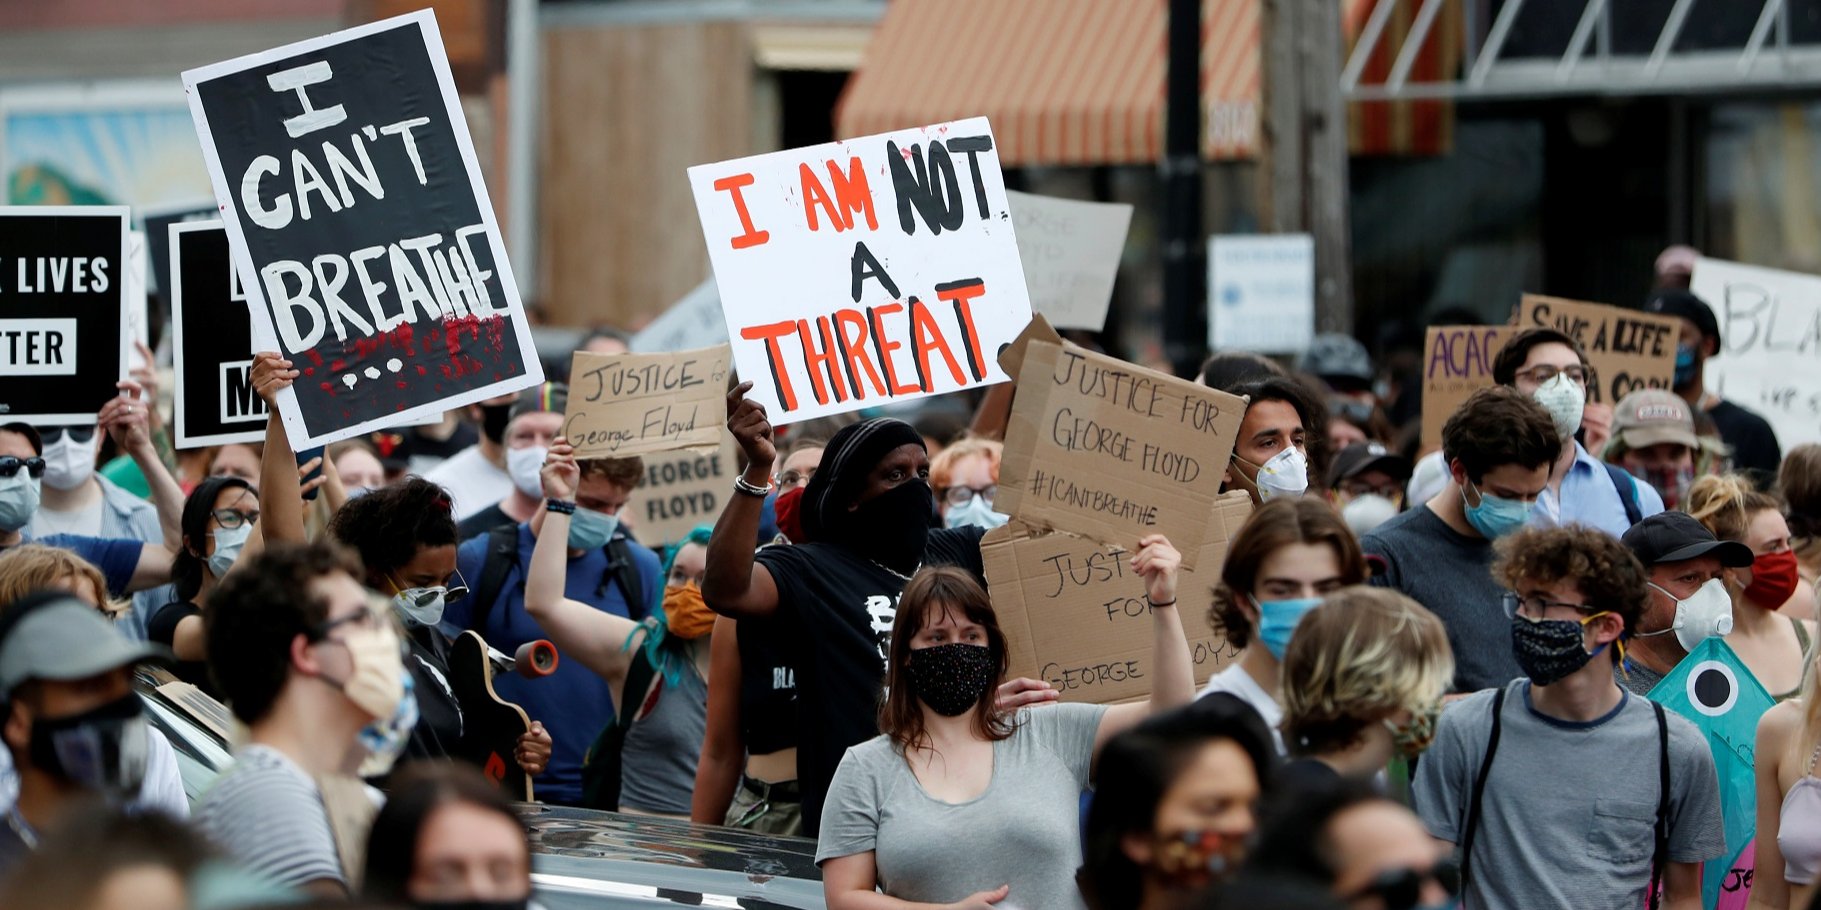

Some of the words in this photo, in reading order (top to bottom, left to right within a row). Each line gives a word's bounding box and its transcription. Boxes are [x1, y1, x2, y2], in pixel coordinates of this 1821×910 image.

[266, 60, 348, 139] I
[241, 116, 430, 230] CAN'T
[713, 172, 770, 250] I
[799, 156, 879, 232] AM
[886, 134, 993, 236] NOT
[17, 256, 110, 294] LIVES
[261, 223, 512, 355] BREATHE
[851, 241, 901, 303] A
[740, 277, 988, 413] THREAT
[582, 360, 705, 401] JUSTICE
[1053, 351, 1166, 418] JUSTICE
[1180, 395, 1220, 437] FOR
[565, 411, 634, 451] George
[641, 405, 699, 441] Floyd
[1052, 408, 1136, 463] GEORGE
[1142, 443, 1201, 483] FLOYD
[636, 455, 723, 489] EORGE
[646, 491, 717, 522] FLOYD
[1041, 661, 1145, 694] GEORGE
